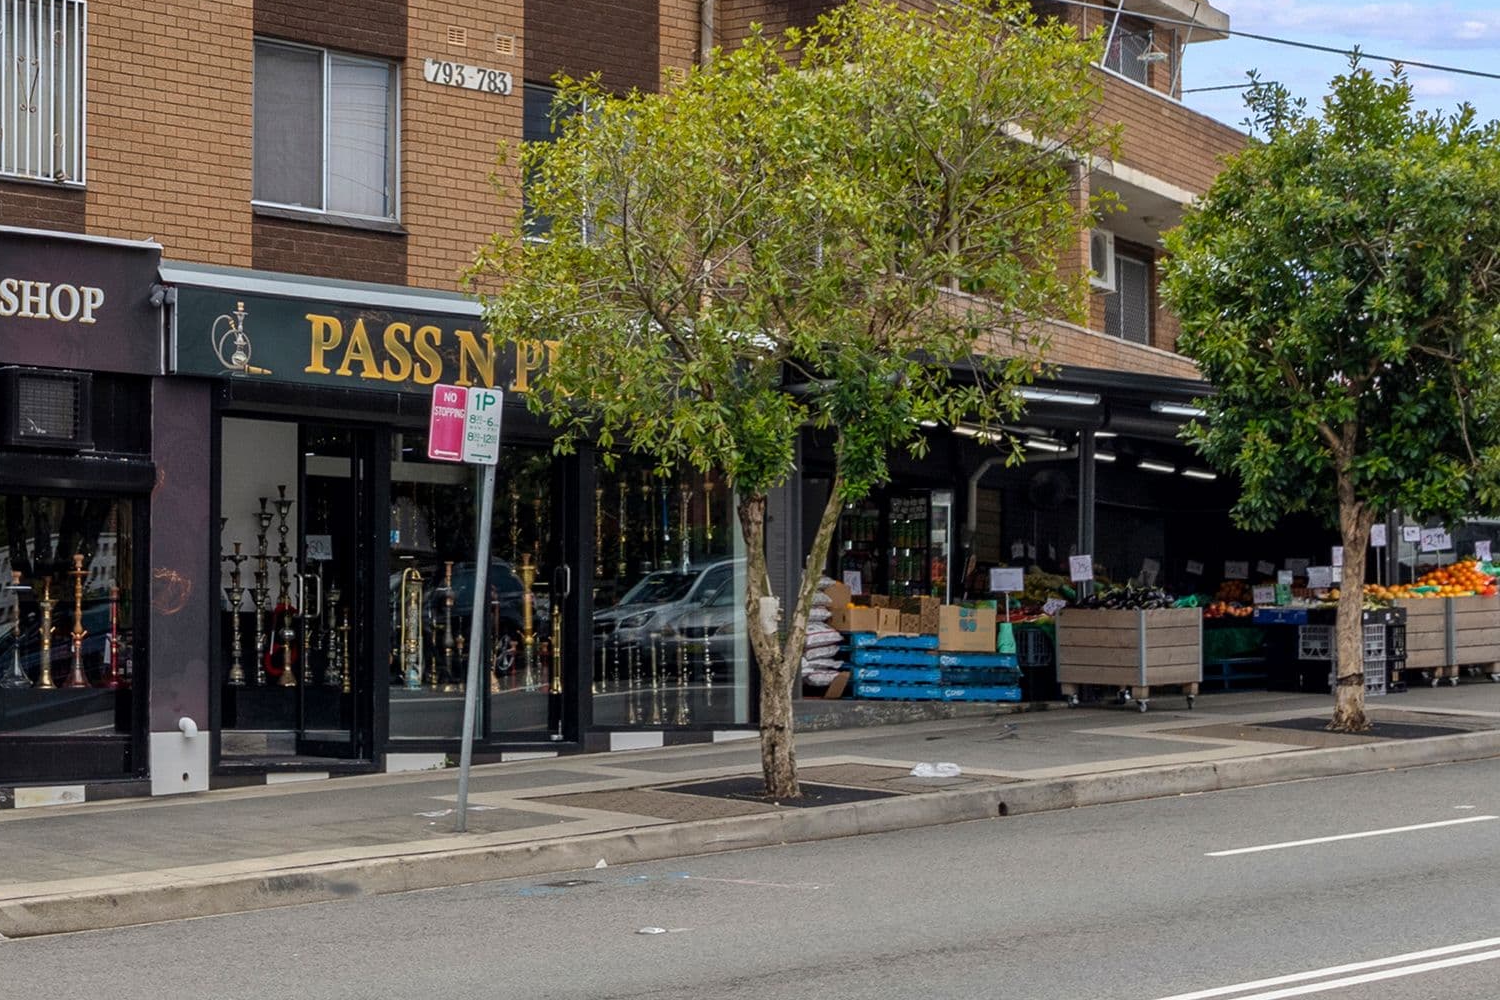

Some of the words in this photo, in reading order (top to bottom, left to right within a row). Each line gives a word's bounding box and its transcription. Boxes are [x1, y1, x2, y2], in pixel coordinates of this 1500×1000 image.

[431, 61, 507, 94] 793-783
[304, 313, 443, 384] PASS
[454, 329, 495, 388] N
[444, 392, 457, 403] NO
[476, 392, 495, 411] 1P
[434, 406, 465, 419] STOPPING
